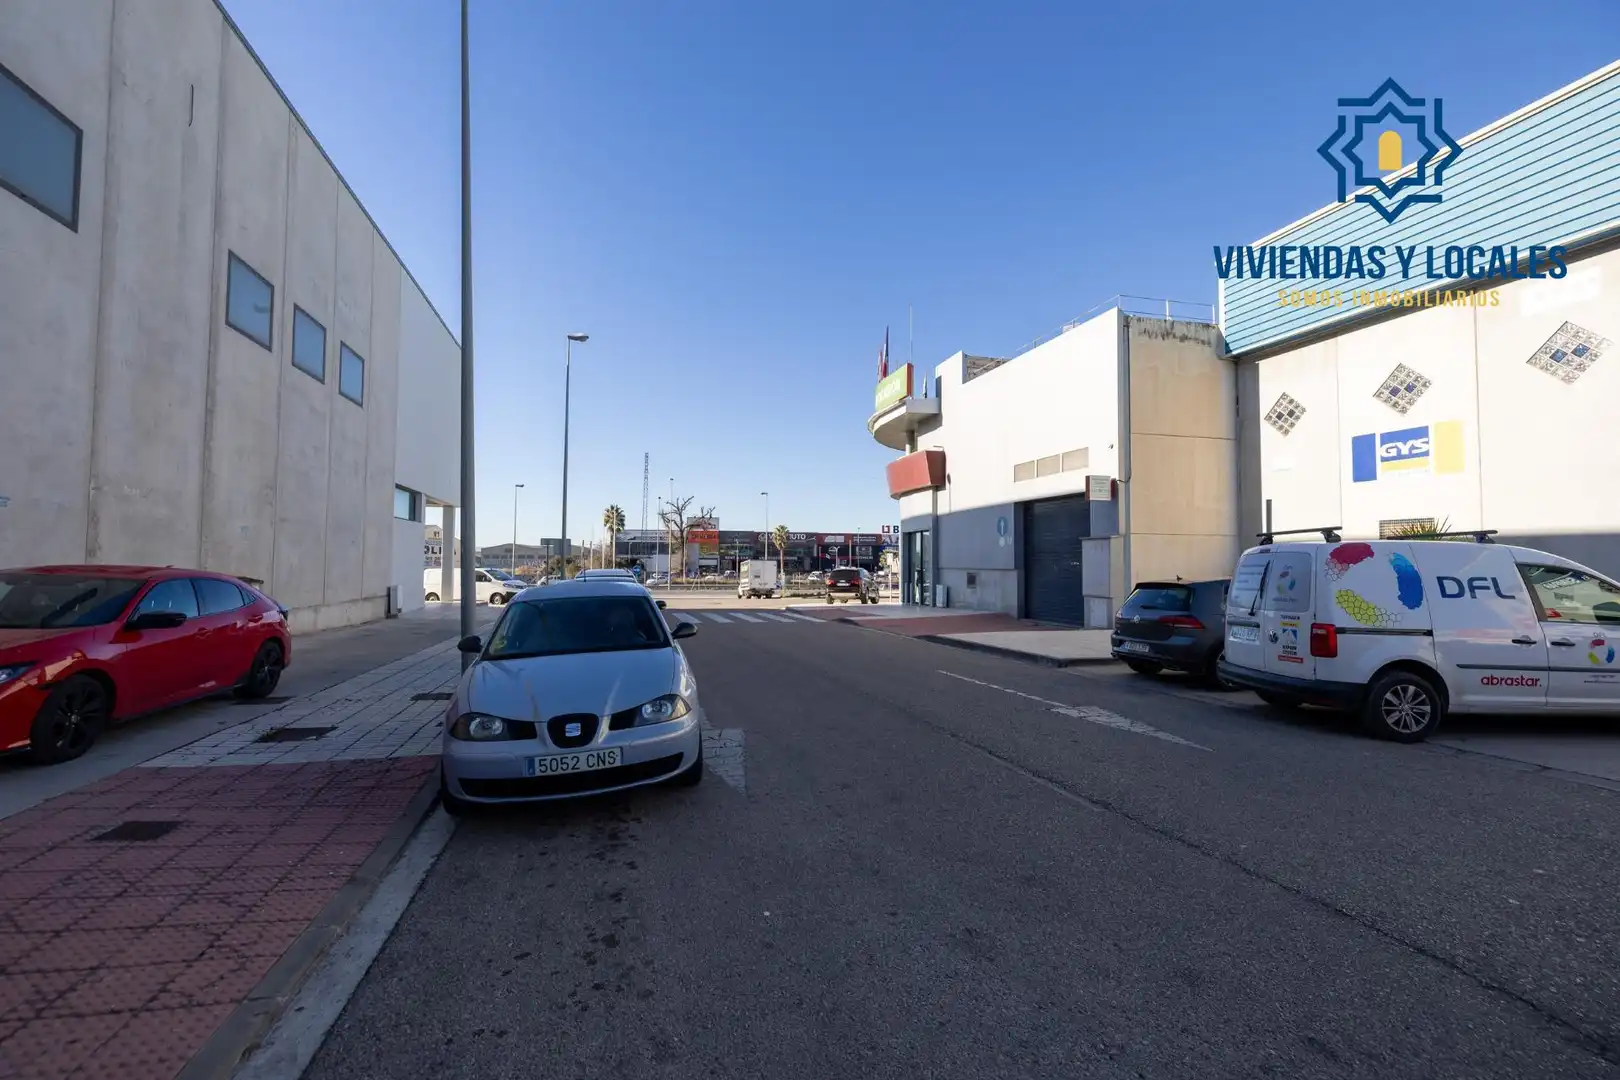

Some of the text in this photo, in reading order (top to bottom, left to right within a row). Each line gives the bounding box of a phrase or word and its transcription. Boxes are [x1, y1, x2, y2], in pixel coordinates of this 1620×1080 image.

[1380, 437, 1429, 458] GYS
[1436, 575, 1516, 600] DFL
[539, 751, 617, 773] 5052 CNS
